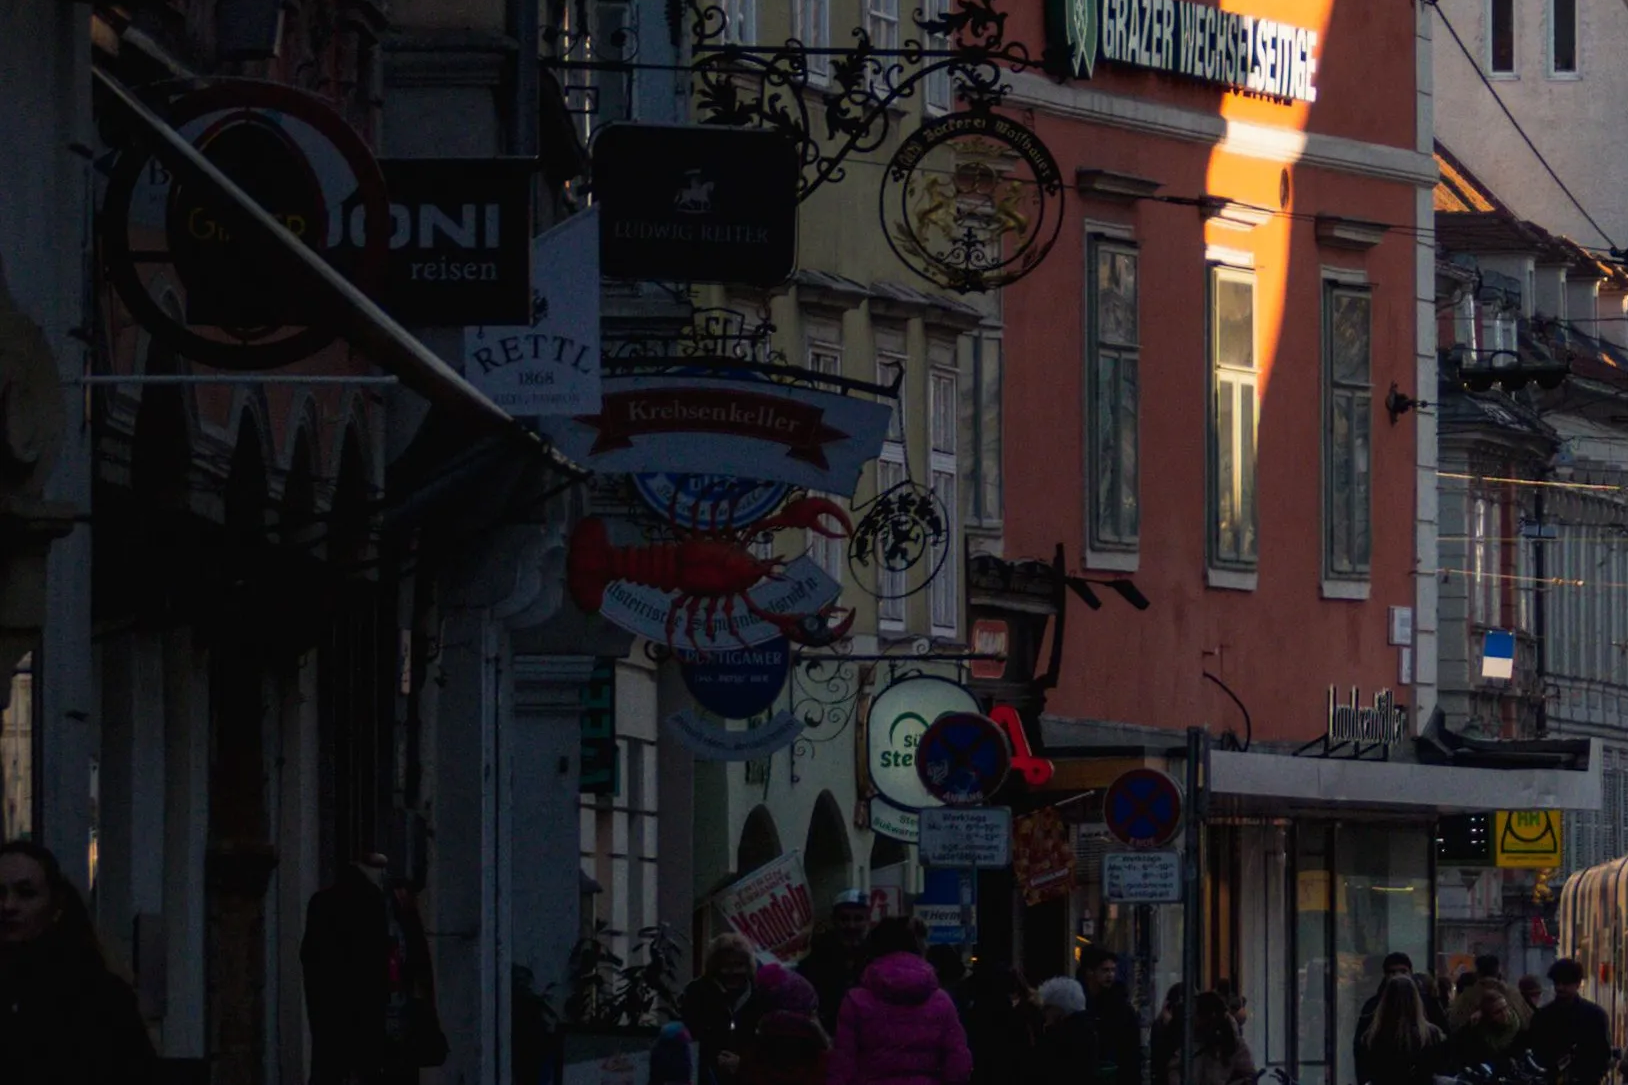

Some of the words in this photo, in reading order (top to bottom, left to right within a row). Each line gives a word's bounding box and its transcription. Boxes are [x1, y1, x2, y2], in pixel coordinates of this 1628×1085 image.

[615, 219, 693, 242] LUDWIG
[701, 223, 771, 245] REITER
[411, 257, 498, 282] reisen
[473, 333, 593, 375] RETTL
[519, 371, 555, 386] 1868
[628, 399, 802, 434] Krebsenkeller
